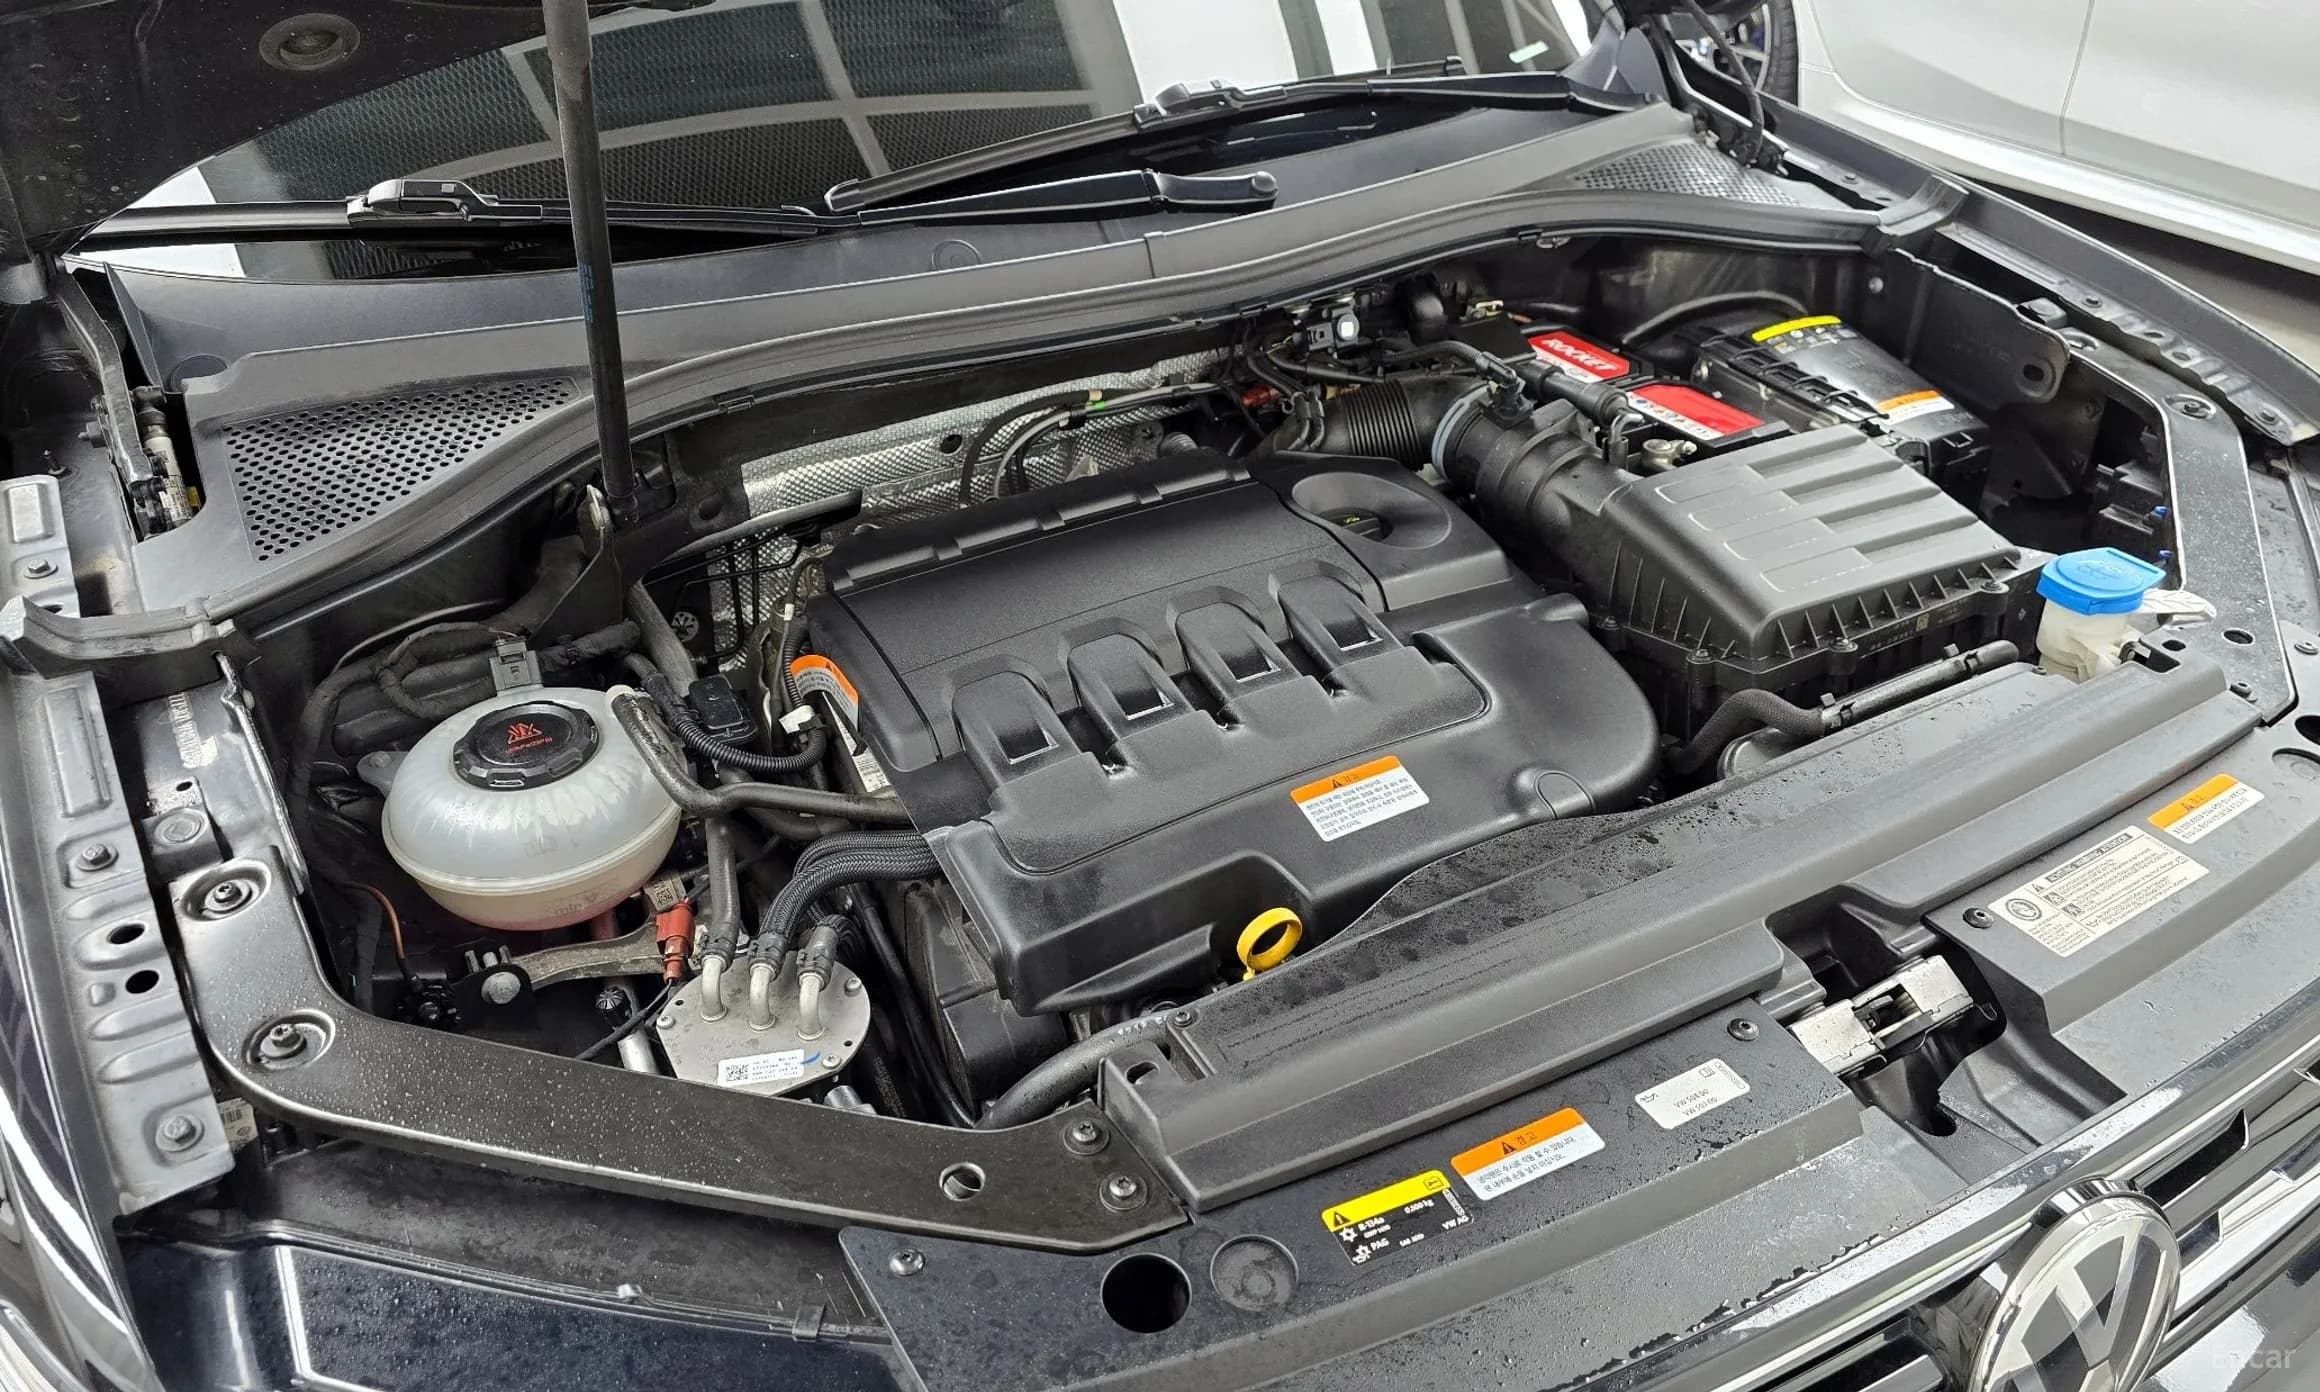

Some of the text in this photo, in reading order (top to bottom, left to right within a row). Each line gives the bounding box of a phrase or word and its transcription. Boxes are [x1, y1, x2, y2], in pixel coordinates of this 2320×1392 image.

[1541, 338, 1617, 371] ROCKET
[1370, 1237, 1390, 1251] PAG
[1442, 1219, 1457, 1230] VW
